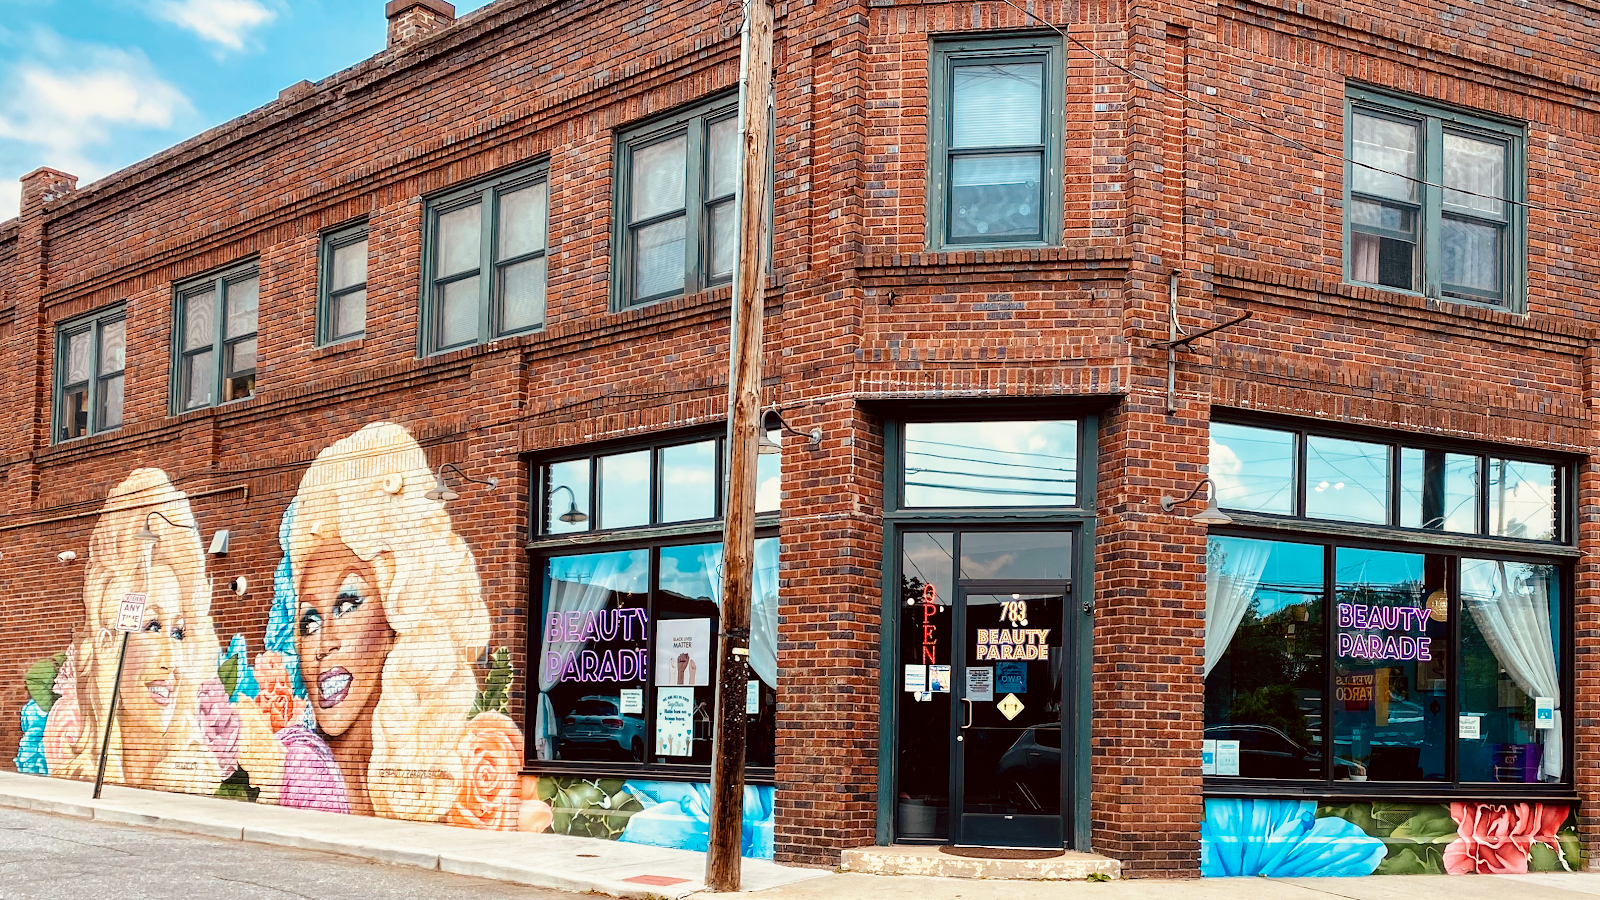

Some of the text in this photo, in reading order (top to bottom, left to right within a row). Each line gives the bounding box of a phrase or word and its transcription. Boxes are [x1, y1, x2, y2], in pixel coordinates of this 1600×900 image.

[545, 608, 647, 642] BEAUTY
[923, 583, 937, 666] OPEN
[999, 600, 1027, 622] 783
[1337, 603, 1432, 632] BEAUTY
[977, 628, 1051, 645] BEAUTY
[1337, 633, 1432, 661] PARADE
[976, 644, 1049, 660] PARADE
